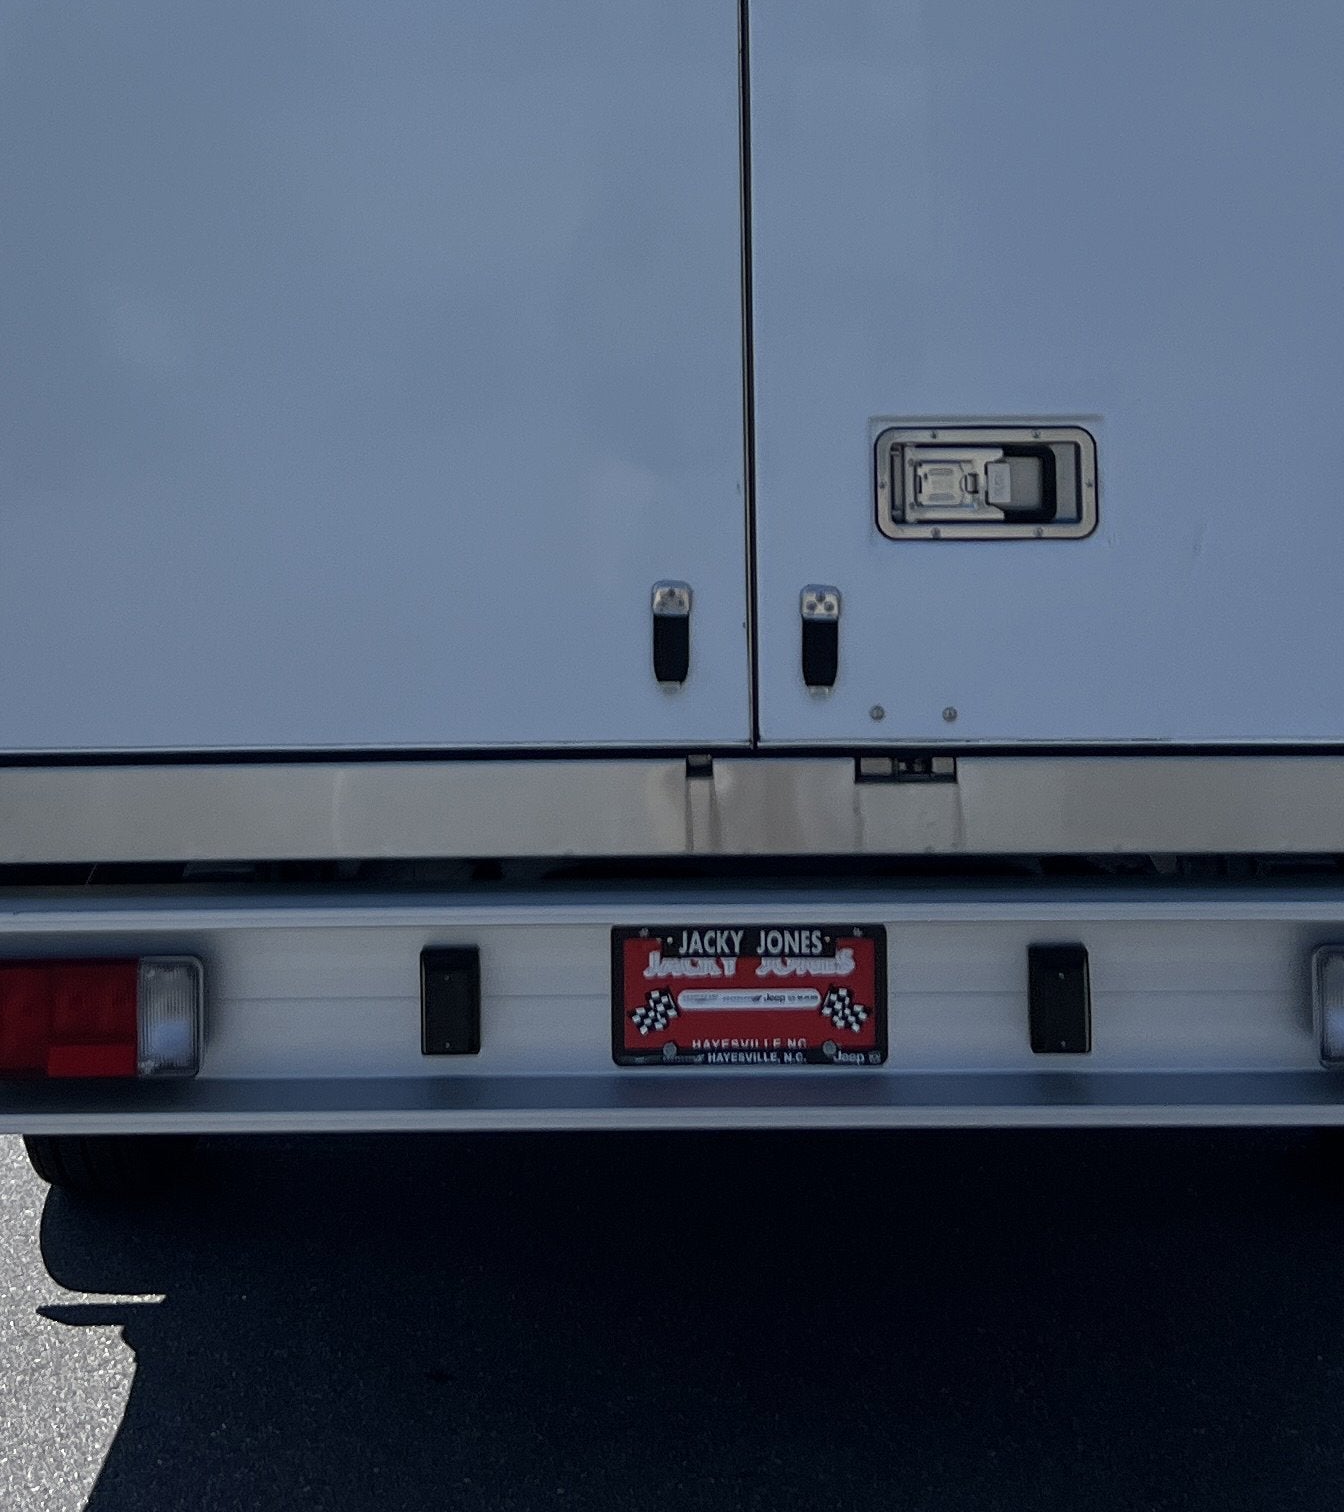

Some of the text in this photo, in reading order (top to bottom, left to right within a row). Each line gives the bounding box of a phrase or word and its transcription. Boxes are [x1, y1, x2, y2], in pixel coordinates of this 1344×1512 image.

[679, 930, 823, 955] JACKY JONES
[833, 1050, 865, 1065] Jeep
